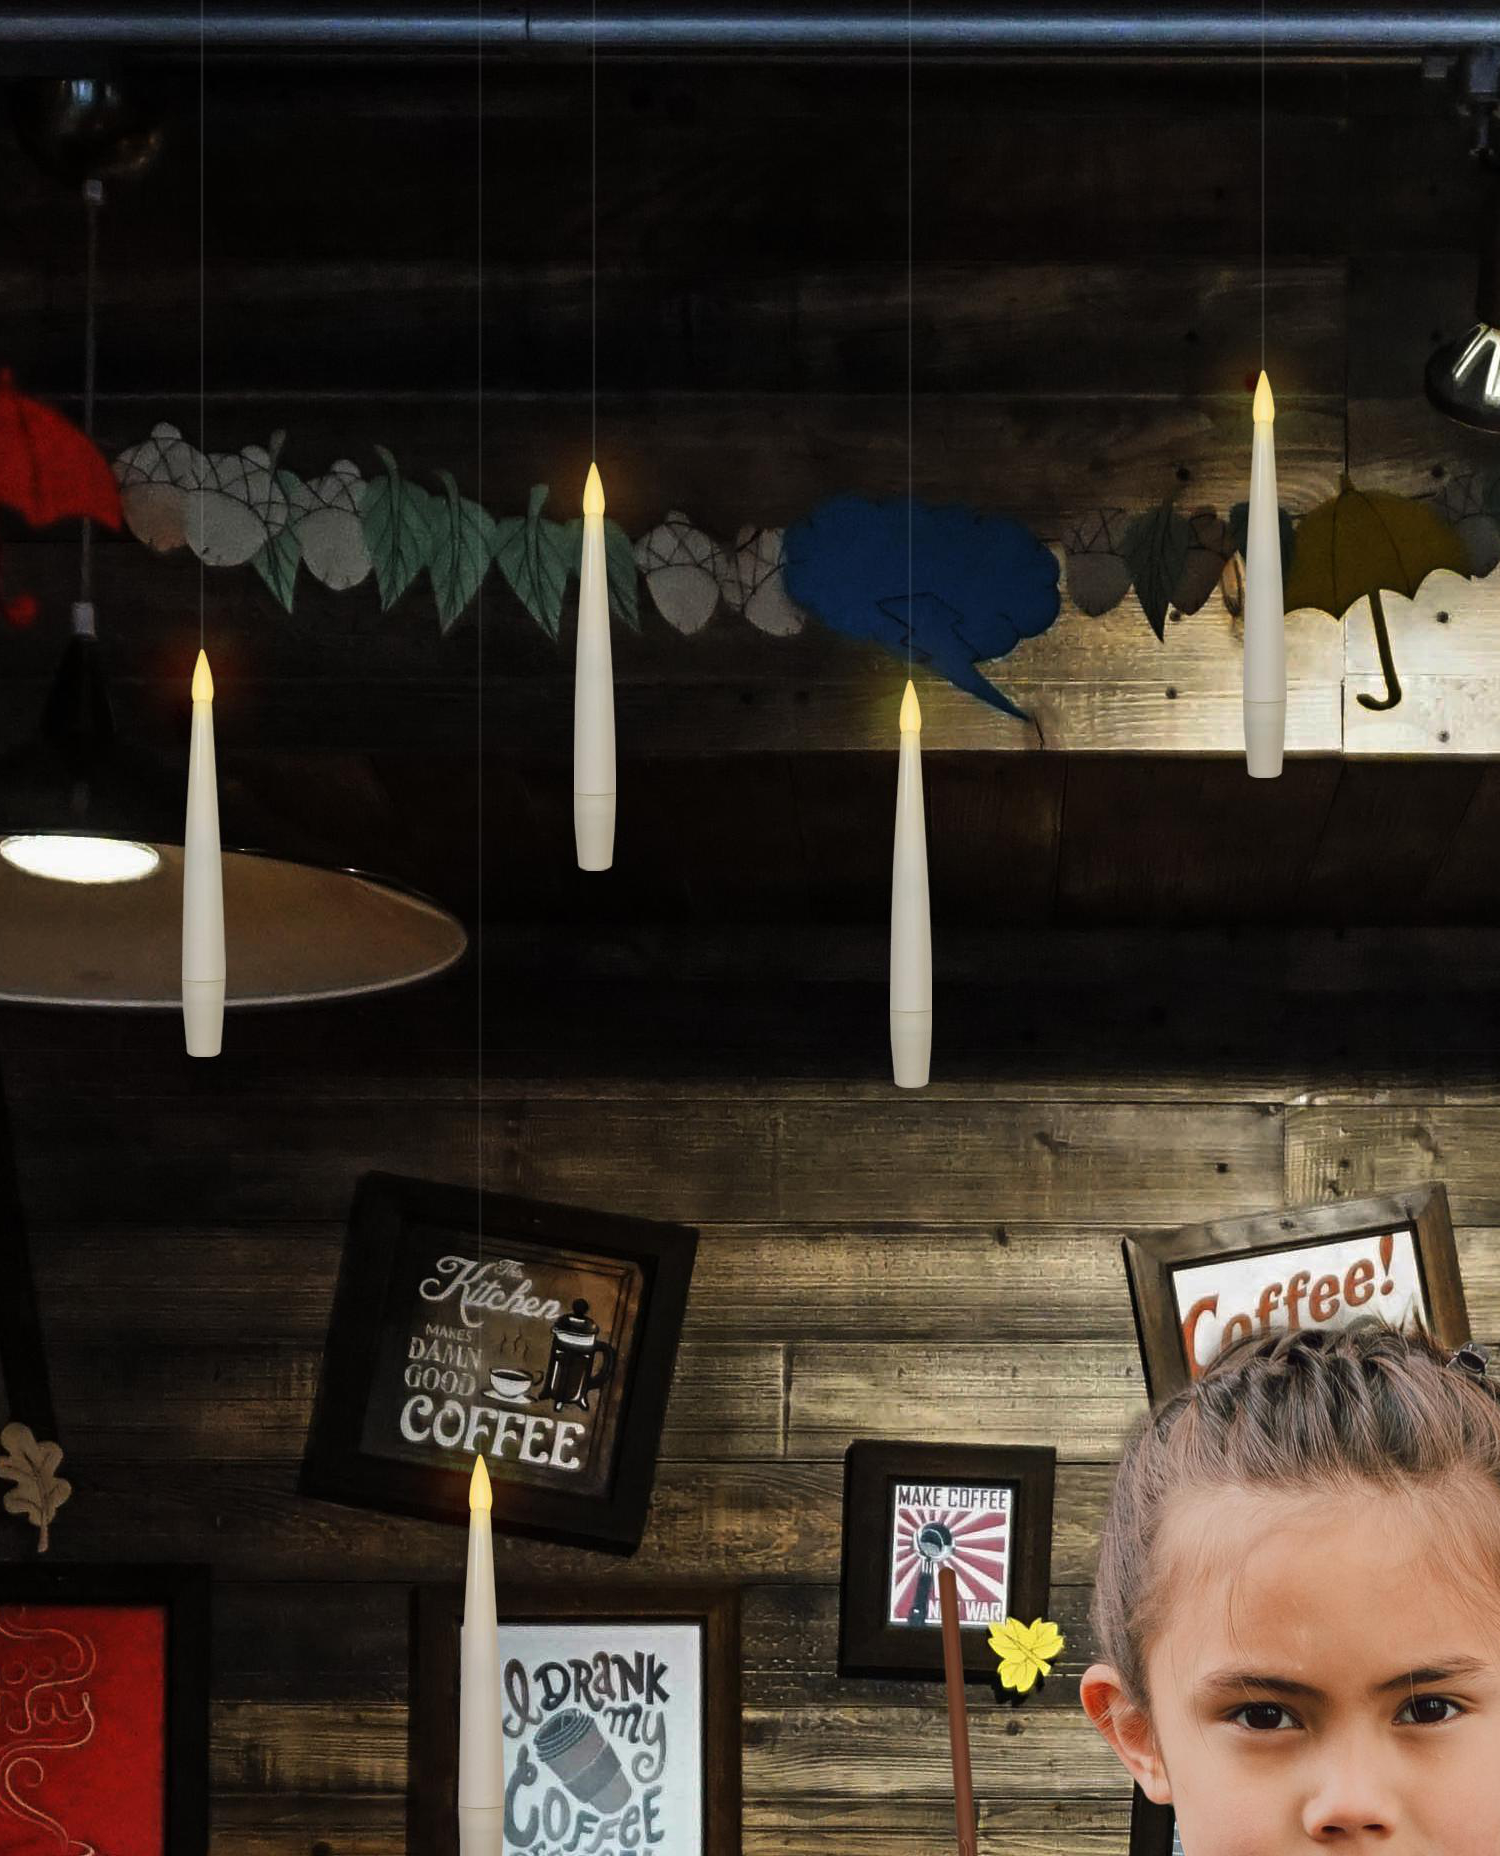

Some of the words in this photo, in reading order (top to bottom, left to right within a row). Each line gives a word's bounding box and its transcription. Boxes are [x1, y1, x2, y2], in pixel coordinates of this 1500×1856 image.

[419, 1255, 562, 1328] Kitchen
[425, 1323, 473, 1343] MAKES
[407, 1336, 484, 1369] DAMN
[404, 1364, 477, 1396] GOOD
[400, 1394, 586, 1470] COFFEE
[899, 1487, 942, 1507] MAKE
[947, 1488, 1007, 1510] COFFEE
[965, 1600, 1002, 1621] WAR
[603, 1703, 666, 1783] my
